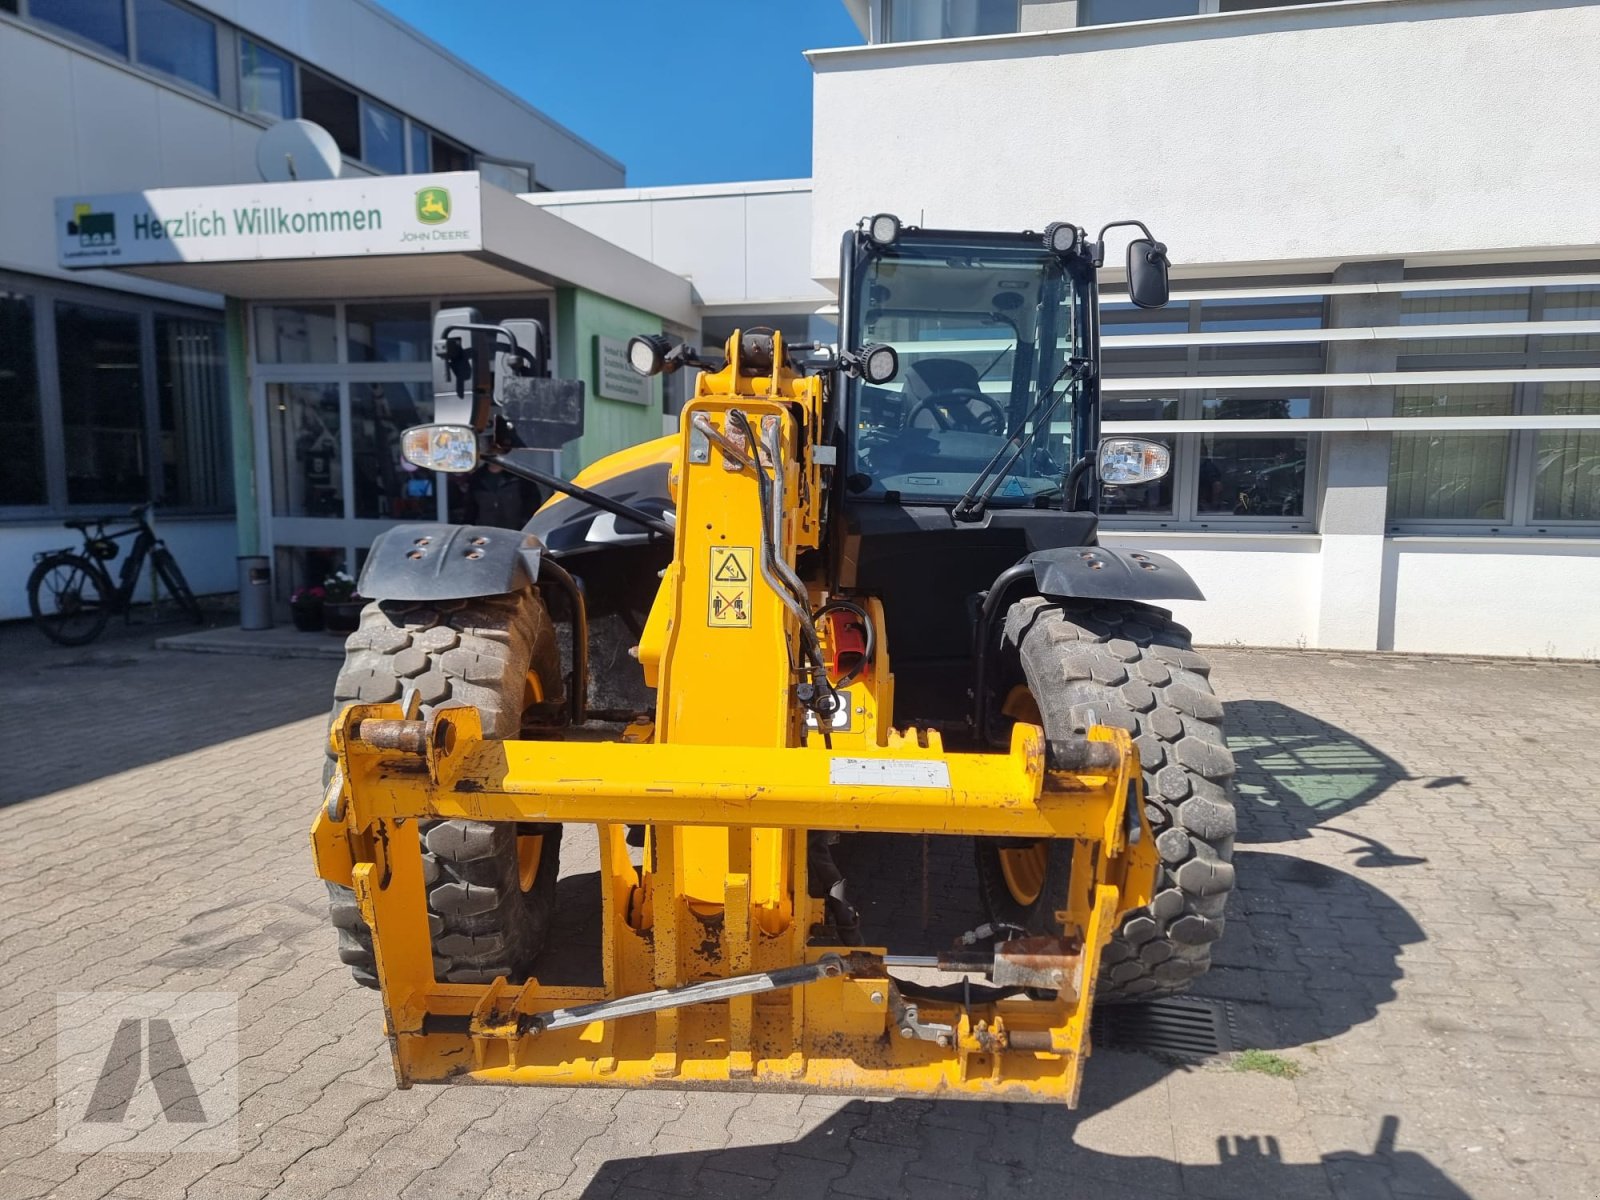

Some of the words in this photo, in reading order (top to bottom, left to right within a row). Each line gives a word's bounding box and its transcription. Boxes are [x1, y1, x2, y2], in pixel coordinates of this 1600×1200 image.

[133, 209, 227, 241] Herzlich
[233, 207, 382, 236] Willkommen
[400, 231, 431, 242] JOHN
[432, 229, 471, 241] DEERE
